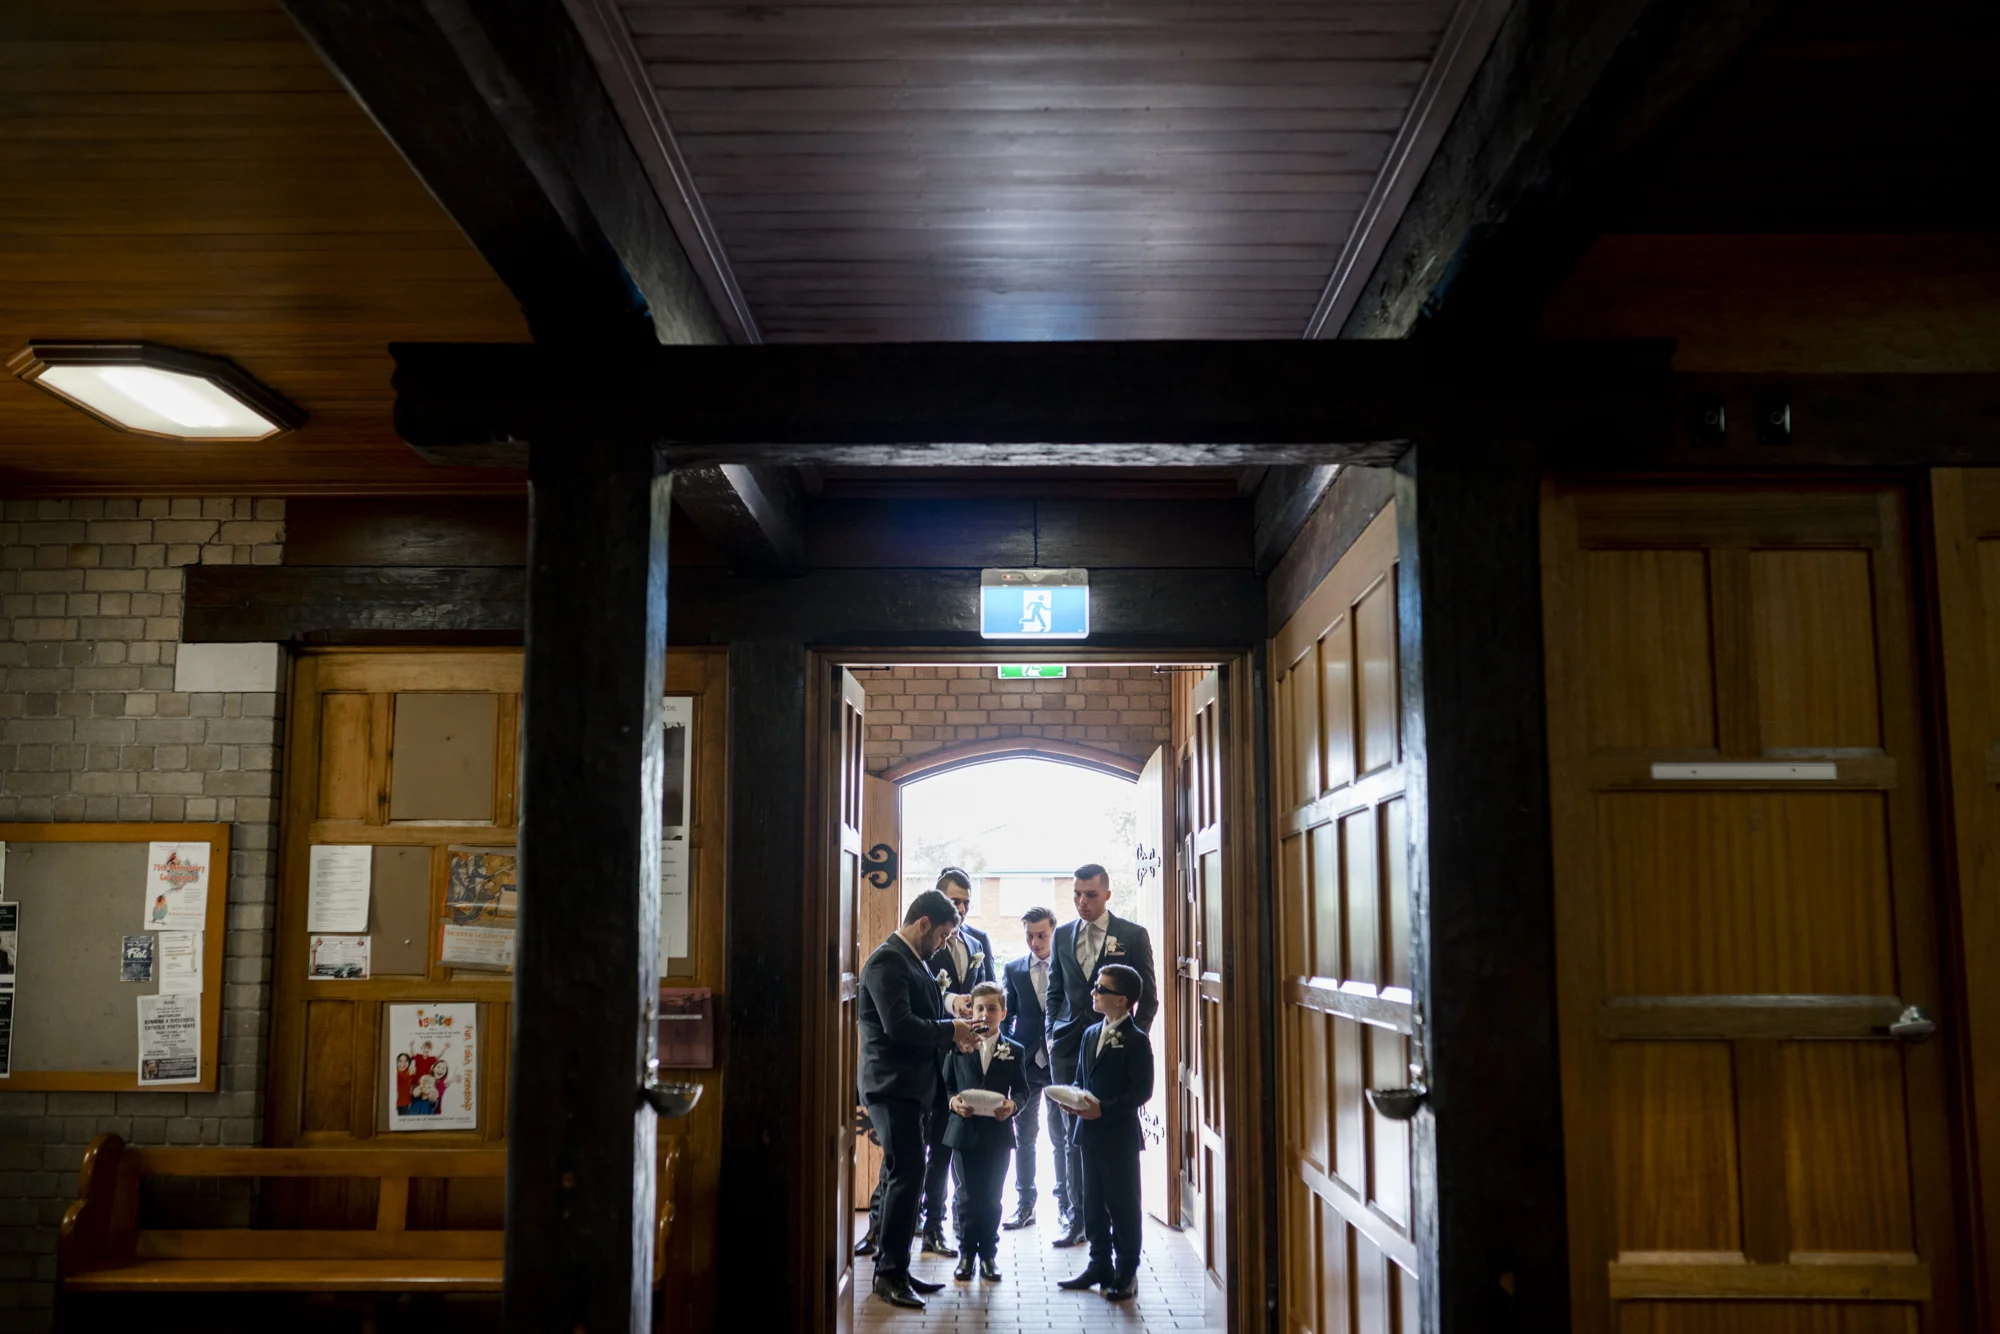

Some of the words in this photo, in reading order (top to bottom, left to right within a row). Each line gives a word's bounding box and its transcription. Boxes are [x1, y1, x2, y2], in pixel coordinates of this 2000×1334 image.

[153, 863, 167, 871] 75th
[169, 864, 205, 873] Anniversary
[461, 1070, 473, 1111] Friendship
